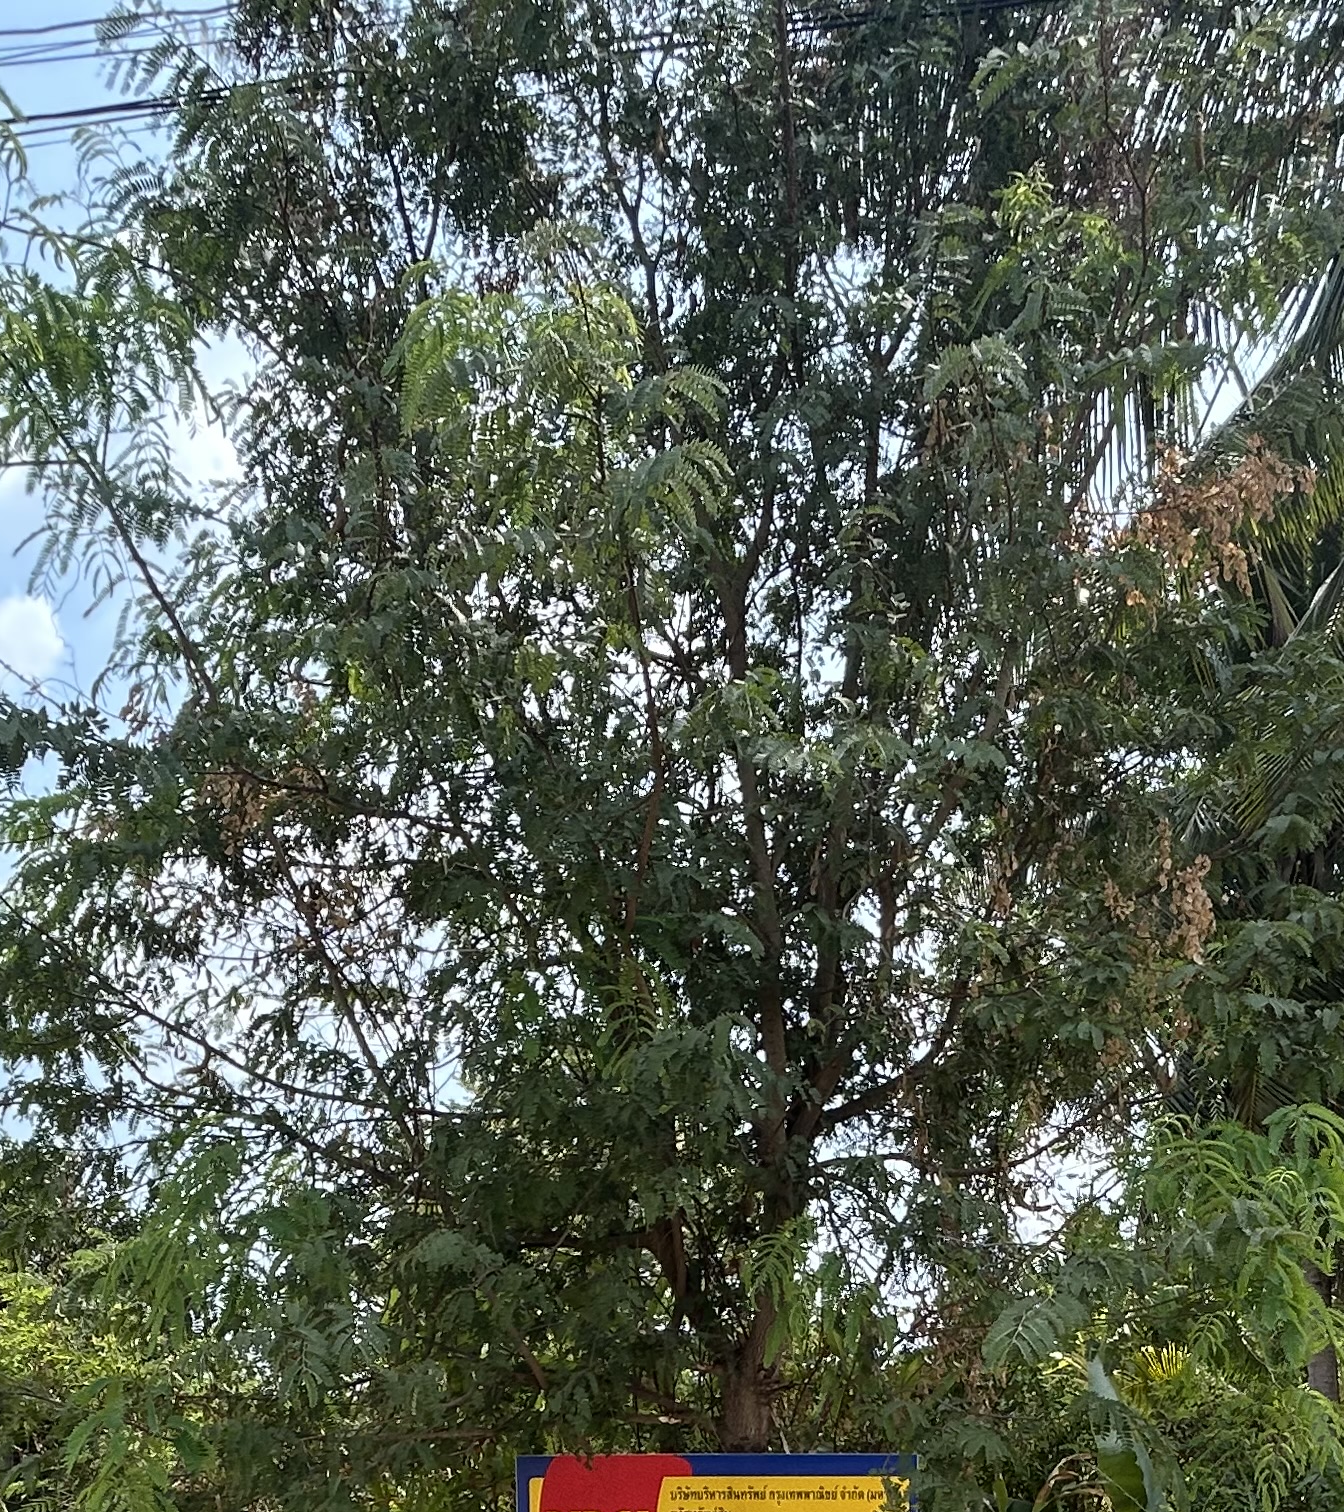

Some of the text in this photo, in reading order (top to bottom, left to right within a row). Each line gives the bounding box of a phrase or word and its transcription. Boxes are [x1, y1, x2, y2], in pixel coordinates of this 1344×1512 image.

[670, 1486, 766, 1501] บริษัทบริหารสินทรัพย์
[840, 1486, 864, 1500] จำกัด
